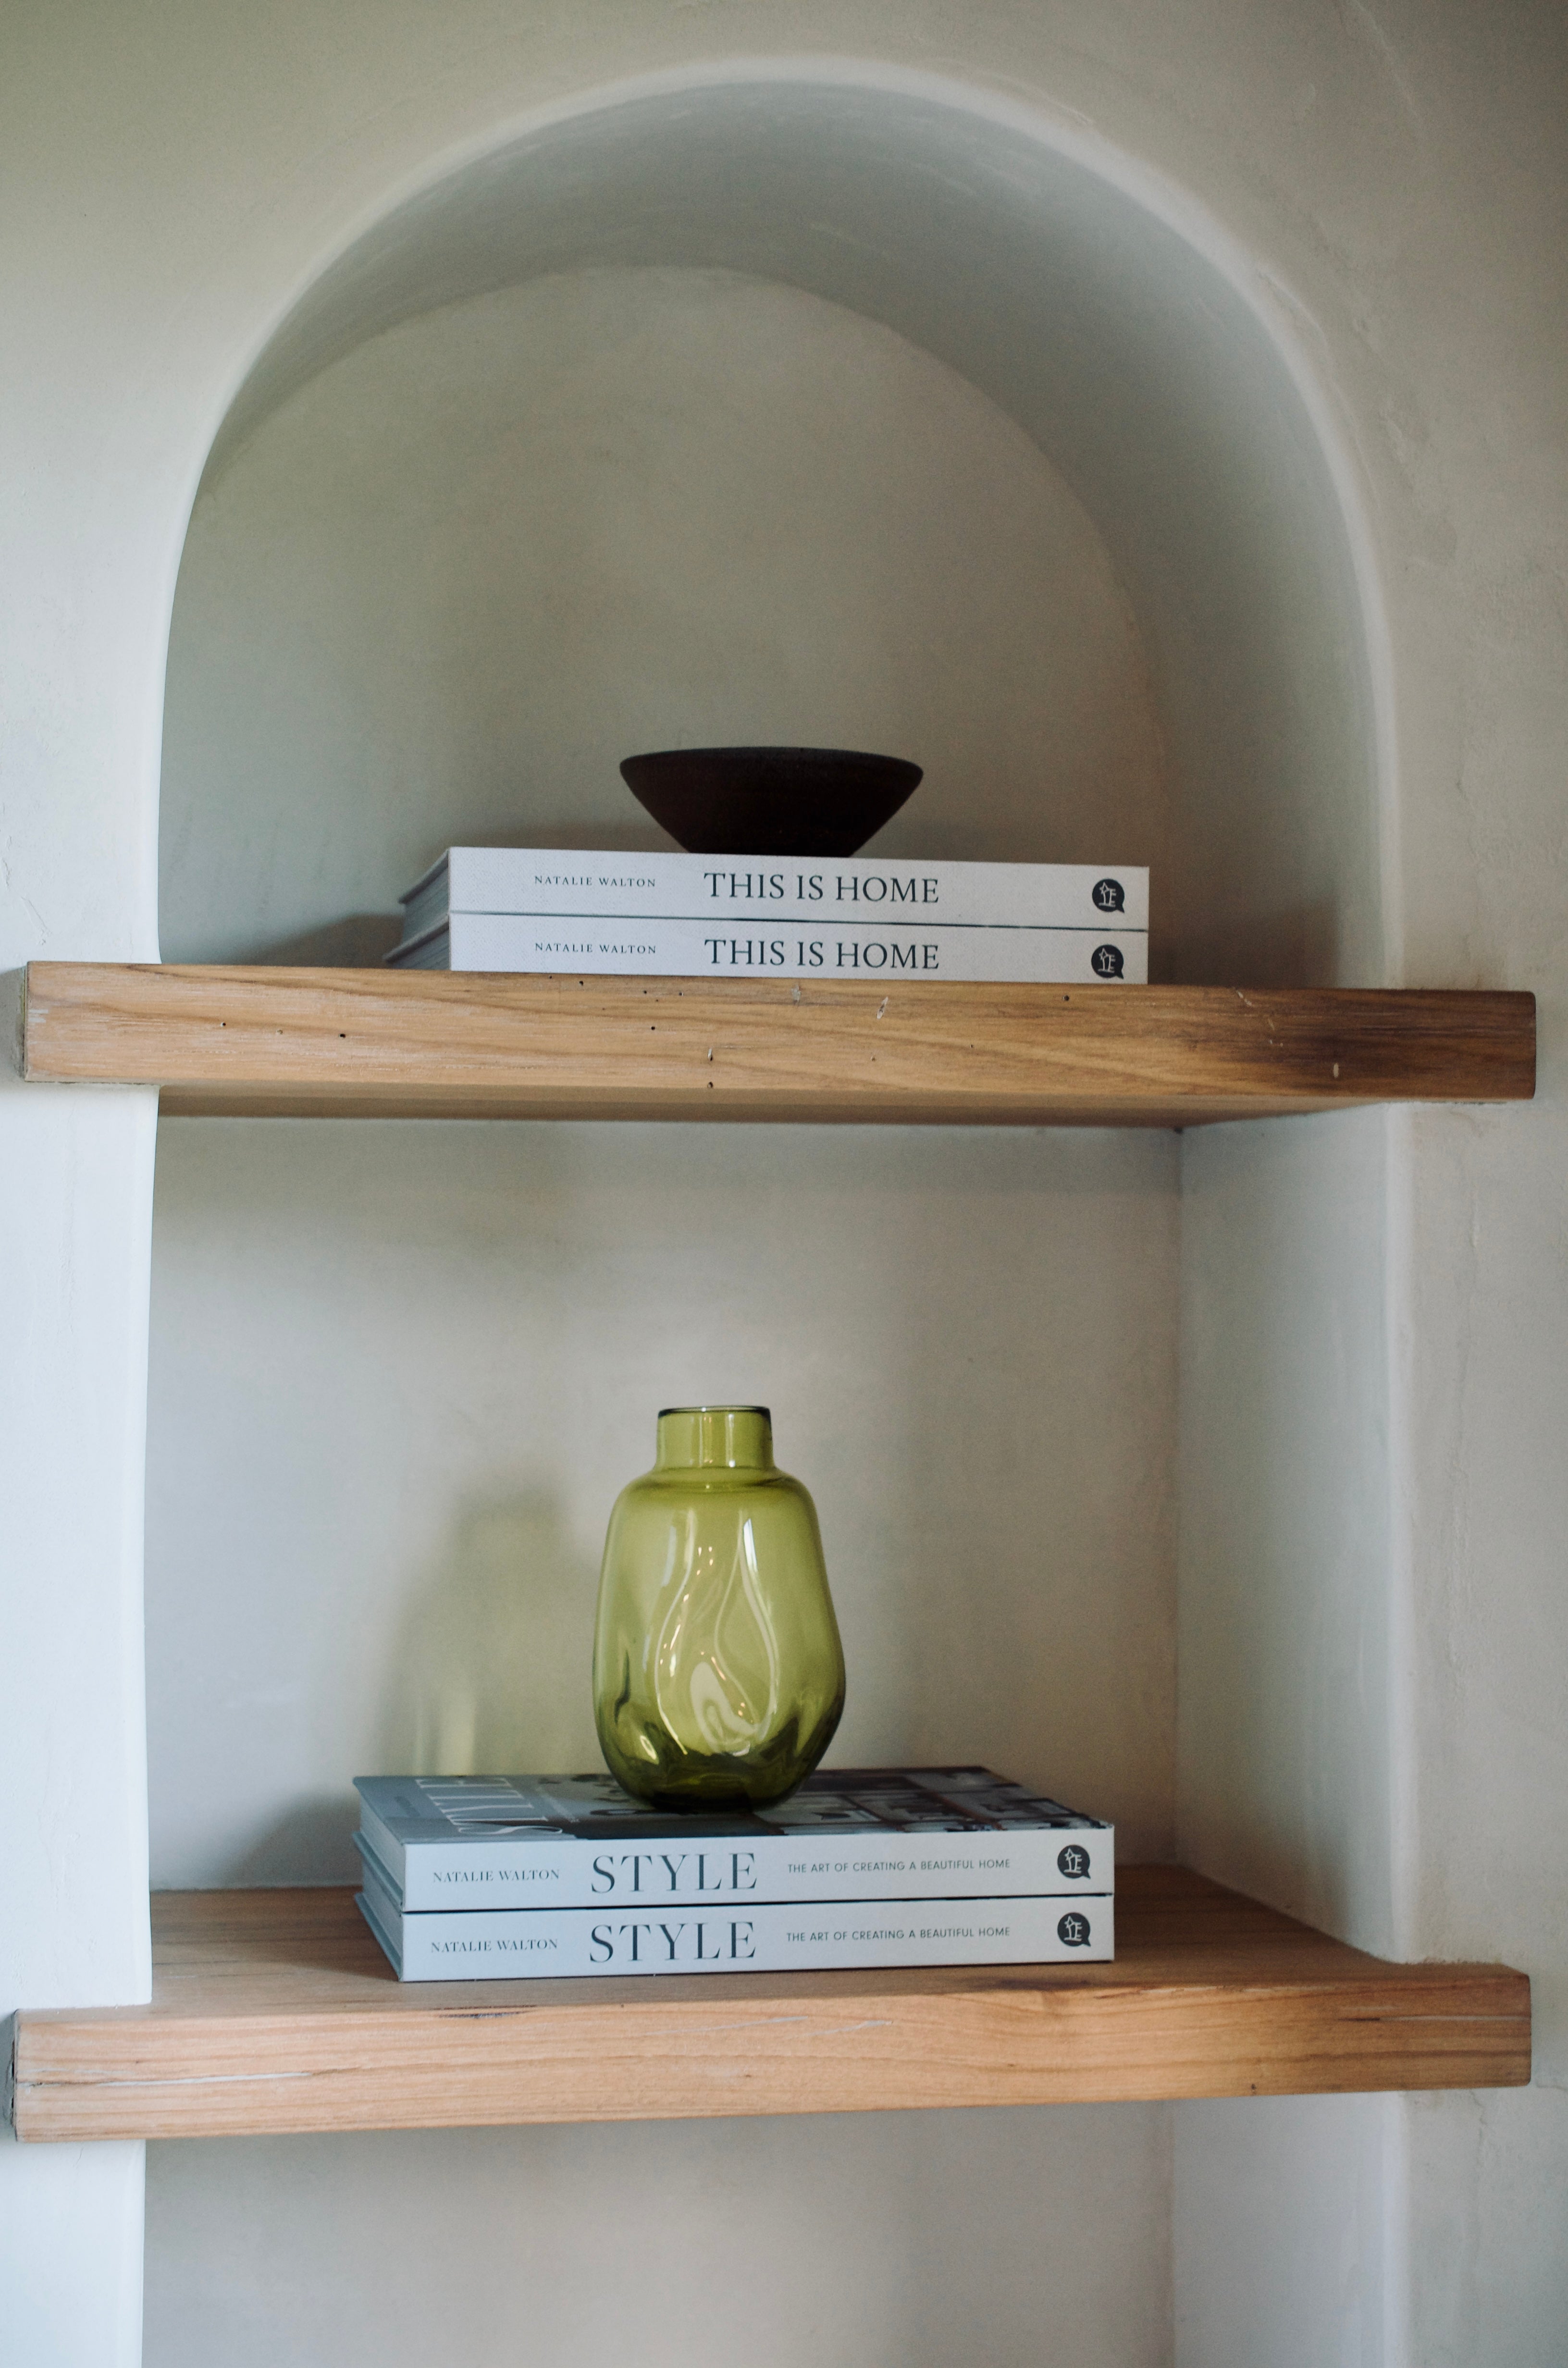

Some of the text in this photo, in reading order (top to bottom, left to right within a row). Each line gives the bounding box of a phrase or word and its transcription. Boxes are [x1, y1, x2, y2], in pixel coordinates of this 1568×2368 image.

[535, 876, 655, 887] NATALIE WALTON
[704, 873, 939, 903] THIS IS HOME
[535, 943, 656, 954] NATALIE WALTON
[704, 939, 939, 970] THIS IS HOME
[415, 1778, 563, 1835] STYLE
[591, 1852, 757, 1893] STYLE
[788, 1859, 1010, 1873] THE ART OF CREATING A BEAUTIFUL HOME
[433, 1869, 559, 1883] NATALIE WALTON
[590, 1921, 756, 1963] STYLE
[787, 1926, 1010, 1942] THE ART OF CREATING A BEAUTIFUL HOME
[432, 1939, 557, 1953] NATALIE WALTON
